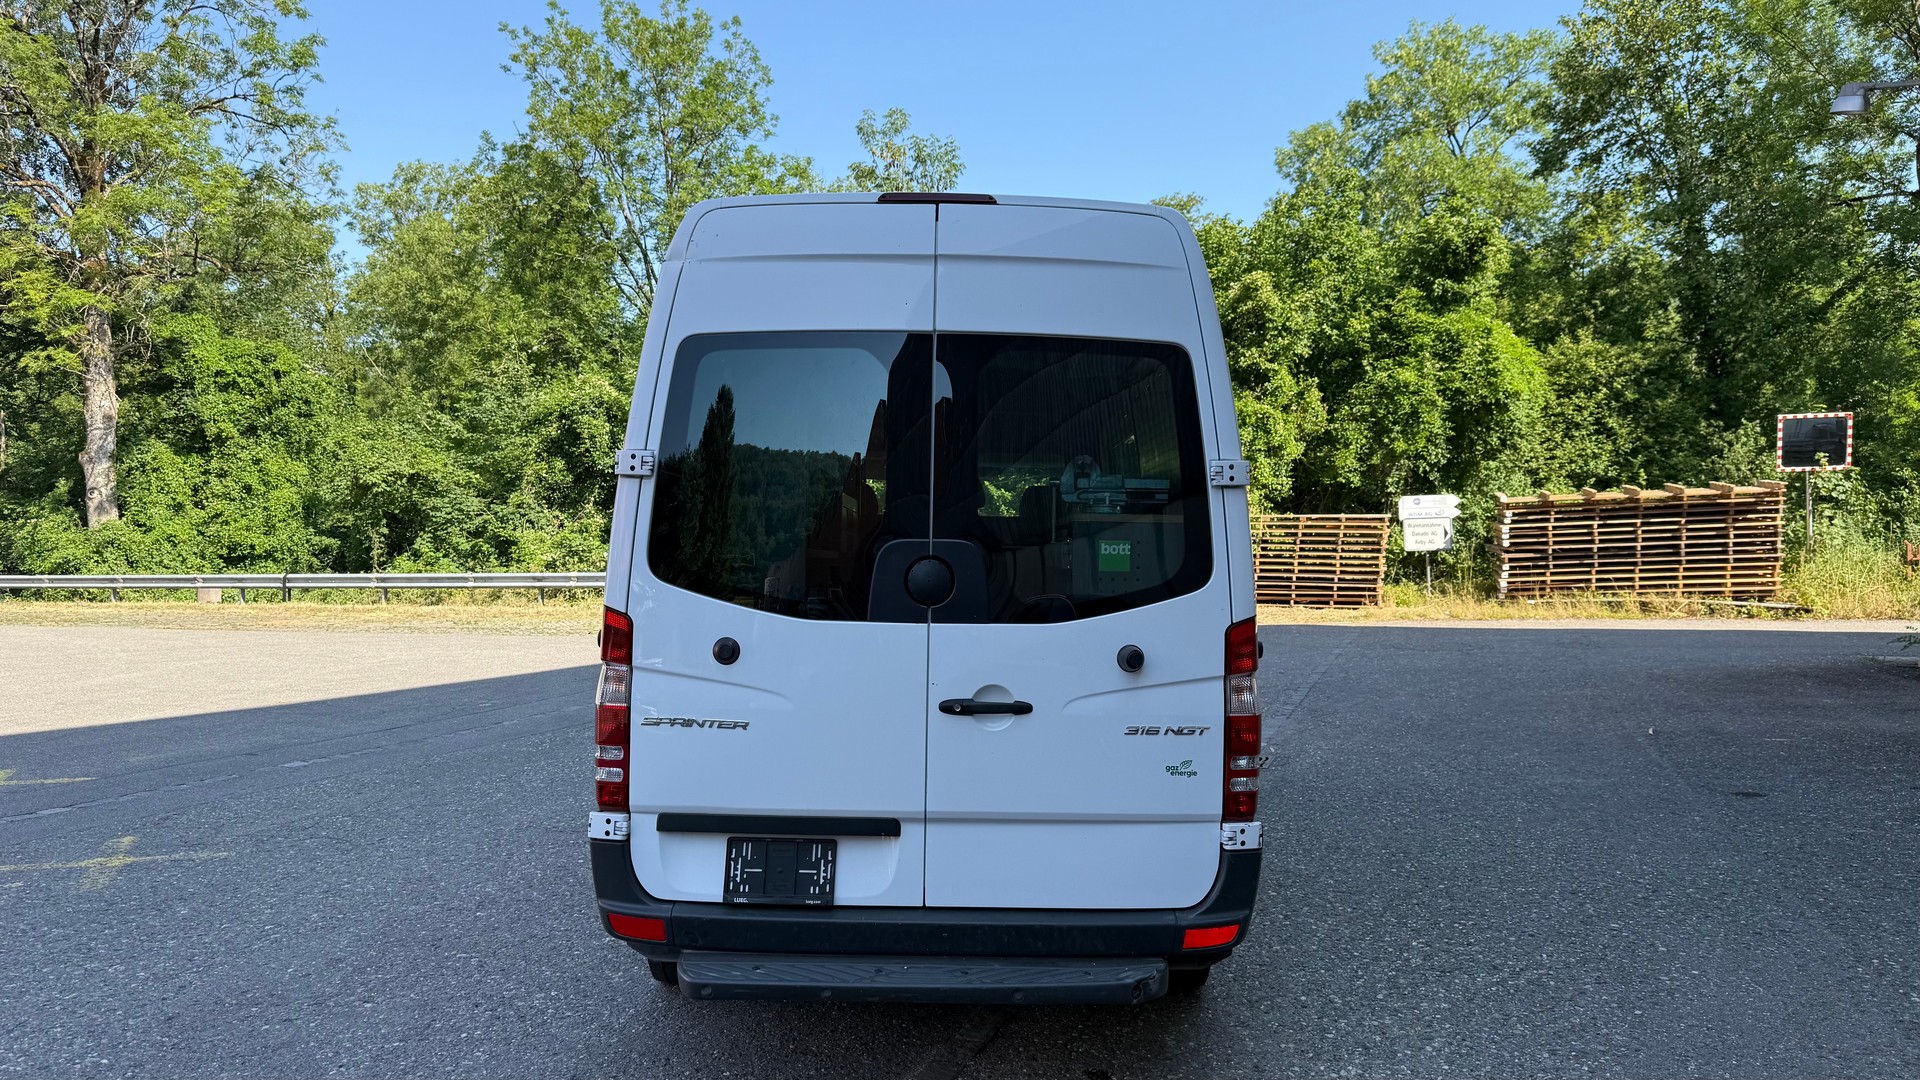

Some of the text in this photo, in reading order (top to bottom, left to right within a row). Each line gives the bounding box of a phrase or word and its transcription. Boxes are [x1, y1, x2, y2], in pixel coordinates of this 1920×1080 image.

[1101, 543, 1131, 554] bott
[640, 716, 750, 730] SPRINTER
[1123, 726, 1211, 736] 316 NGT
[1170, 770, 1198, 778] energie
